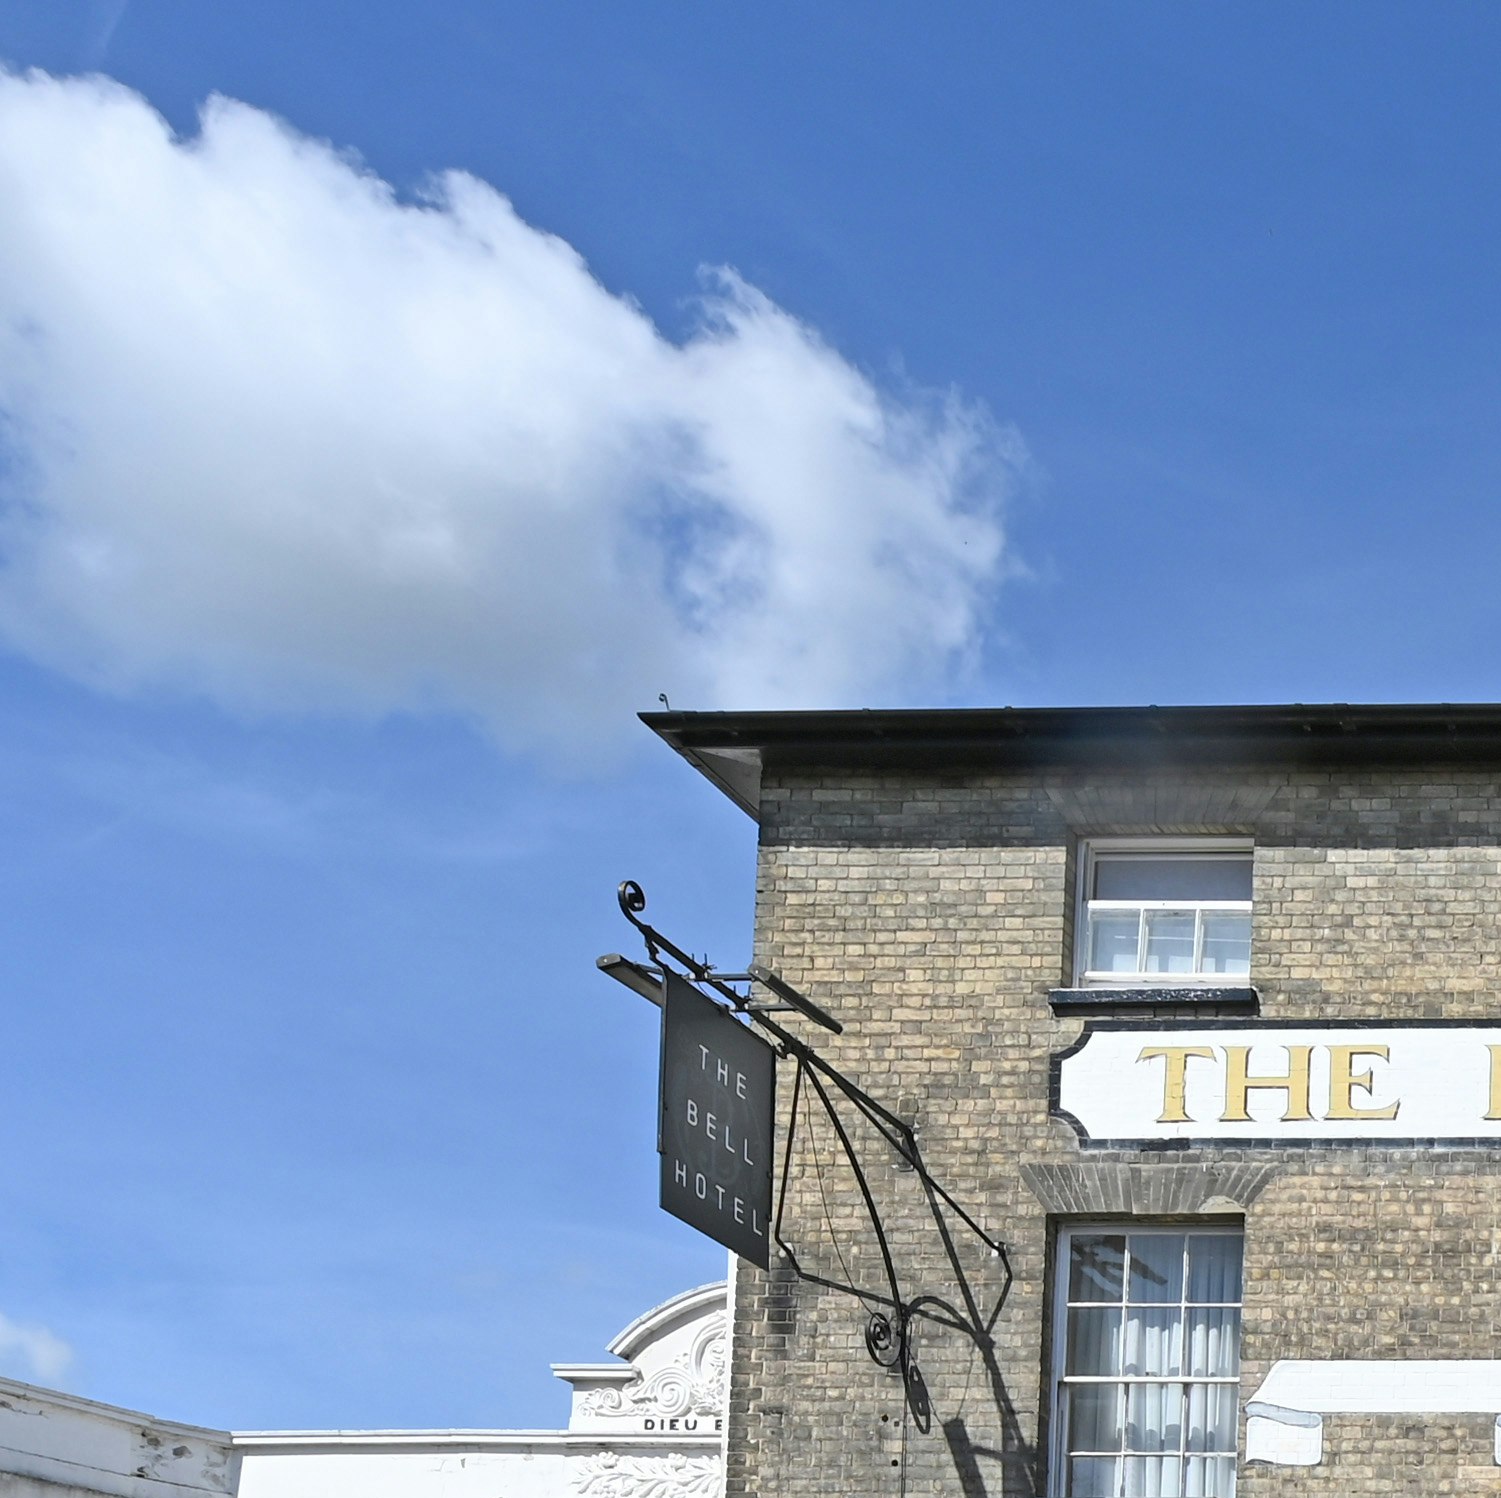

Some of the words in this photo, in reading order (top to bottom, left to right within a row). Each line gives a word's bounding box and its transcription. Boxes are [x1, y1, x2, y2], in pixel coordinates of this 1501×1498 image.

[698, 1043, 748, 1101] THE
[1137, 1045, 1401, 1123] THE
[687, 1098, 755, 1168] BELL
[674, 1158, 764, 1238] HOTEL
[643, 1418, 698, 1431] DIEU
